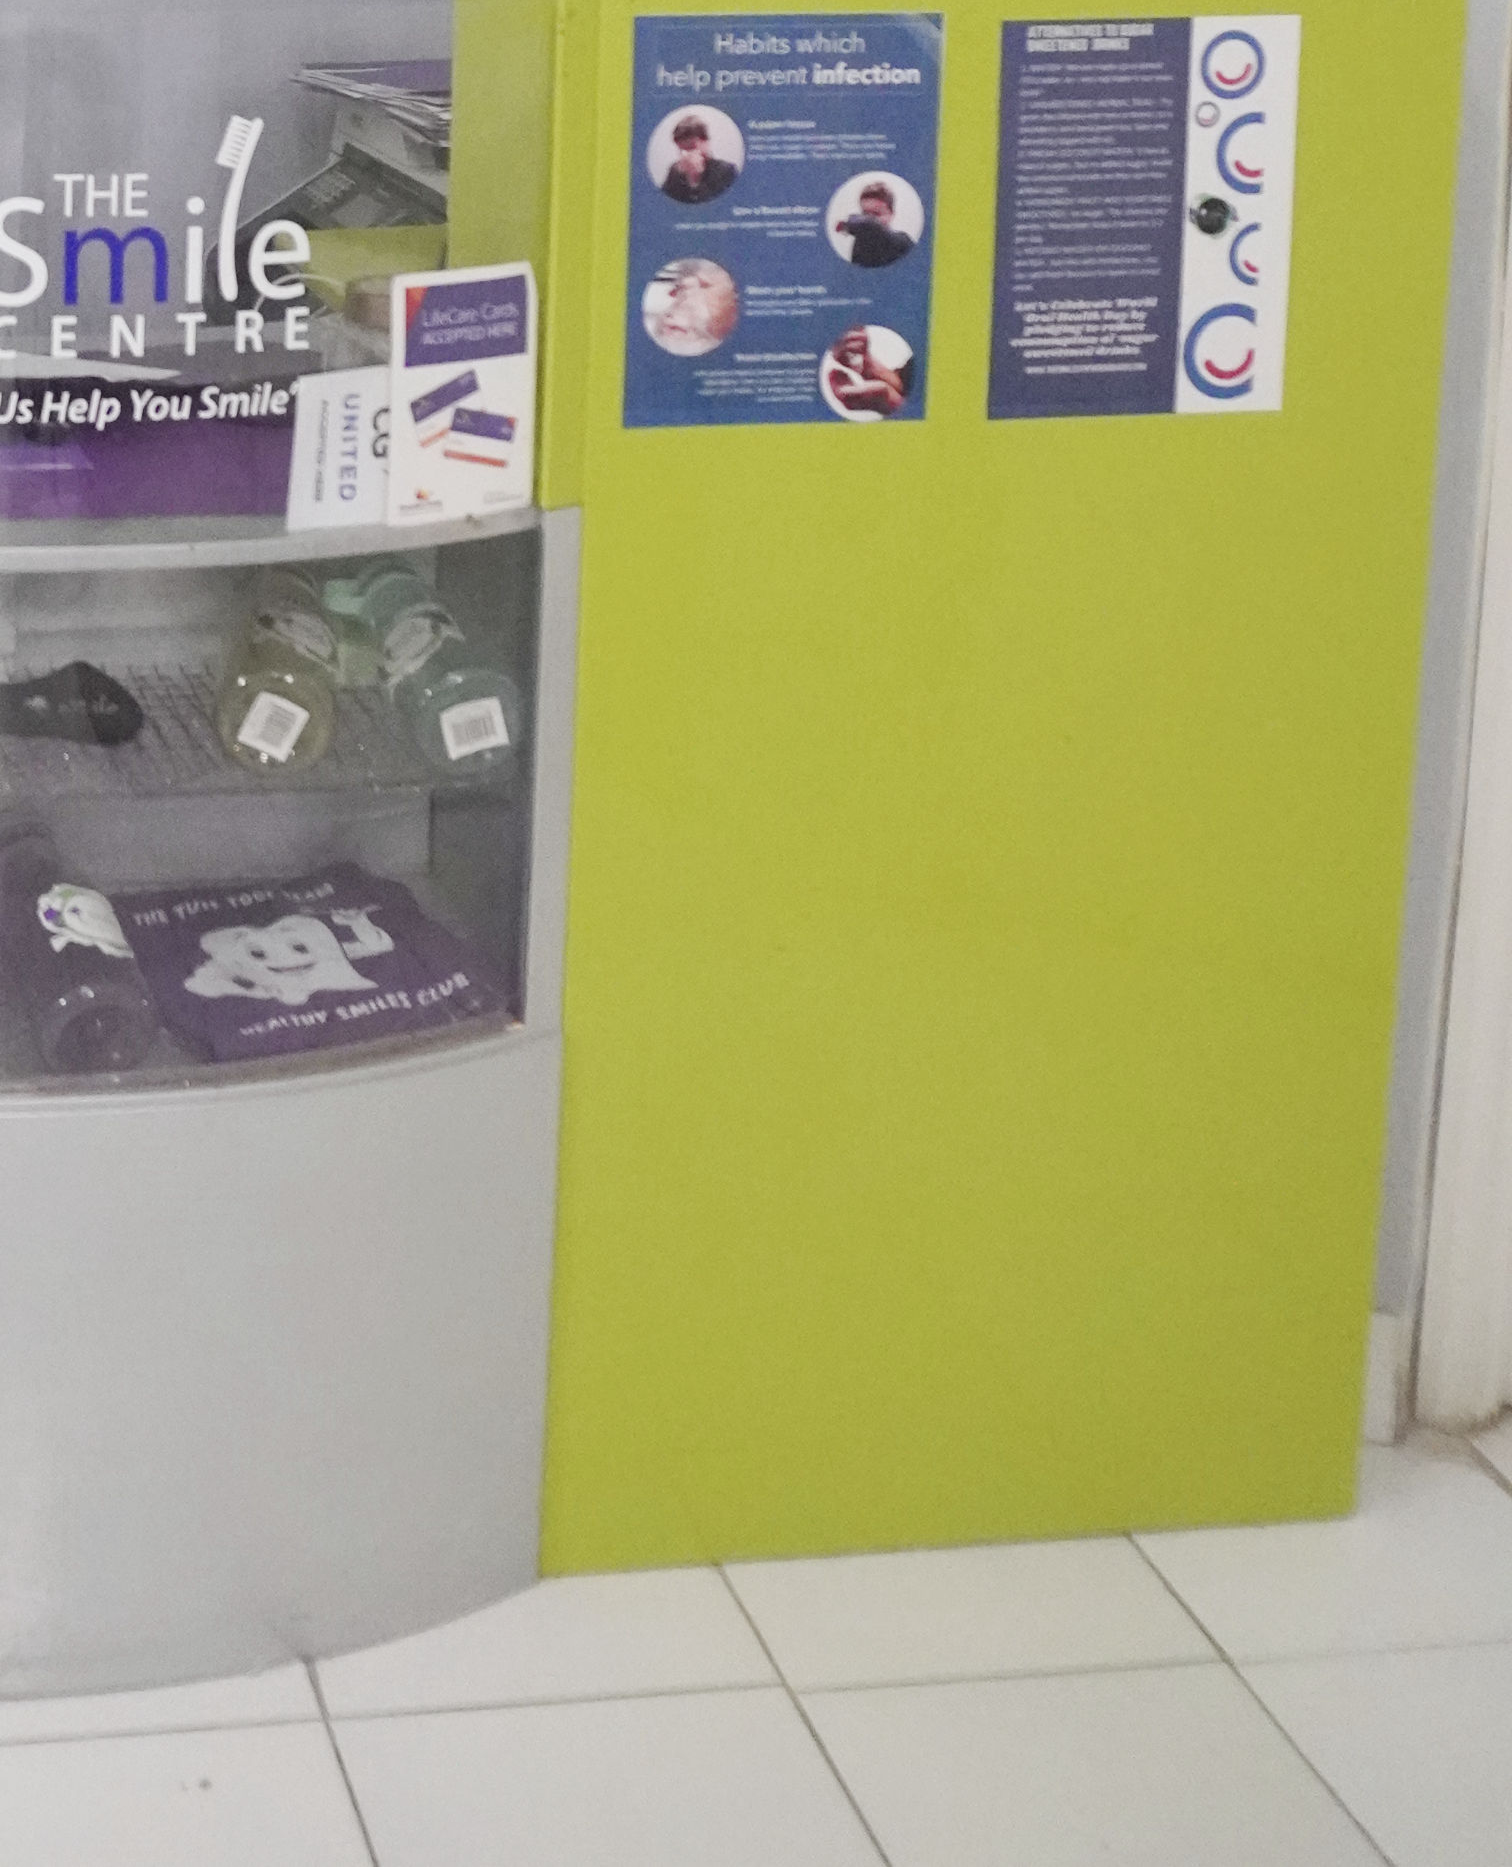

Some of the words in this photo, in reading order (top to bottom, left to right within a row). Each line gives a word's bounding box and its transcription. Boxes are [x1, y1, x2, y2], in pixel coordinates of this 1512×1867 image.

[713, 31, 791, 55] Habits
[796, 30, 866, 54] which
[656, 64, 711, 91] help
[715, 66, 808, 91] prevent
[812, 61, 922, 85] infection
[54, 173, 149, 217] THE
[40, 389, 122, 431] Help
[129, 389, 192, 422] You
[337, 393, 360, 501] UNITED
